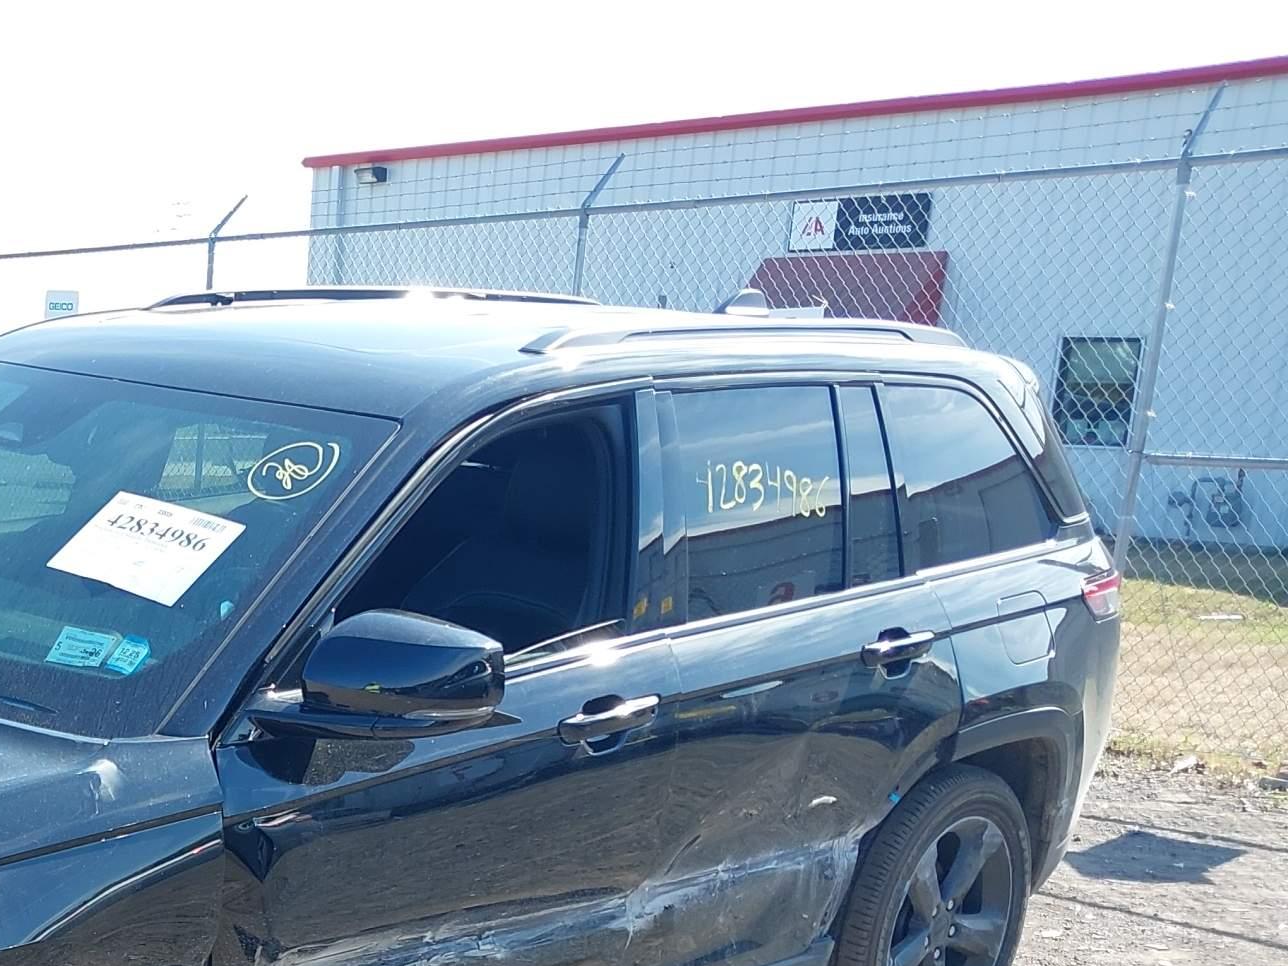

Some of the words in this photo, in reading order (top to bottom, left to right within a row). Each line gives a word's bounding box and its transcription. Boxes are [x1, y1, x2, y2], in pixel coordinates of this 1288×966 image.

[848, 225, 869, 235] Auto
[871, 223, 912, 235] Auctions
[49, 302, 74, 311] GEICO
[695, 460, 830, 517] 42834986
[107, 513, 210, 551] 42834986
